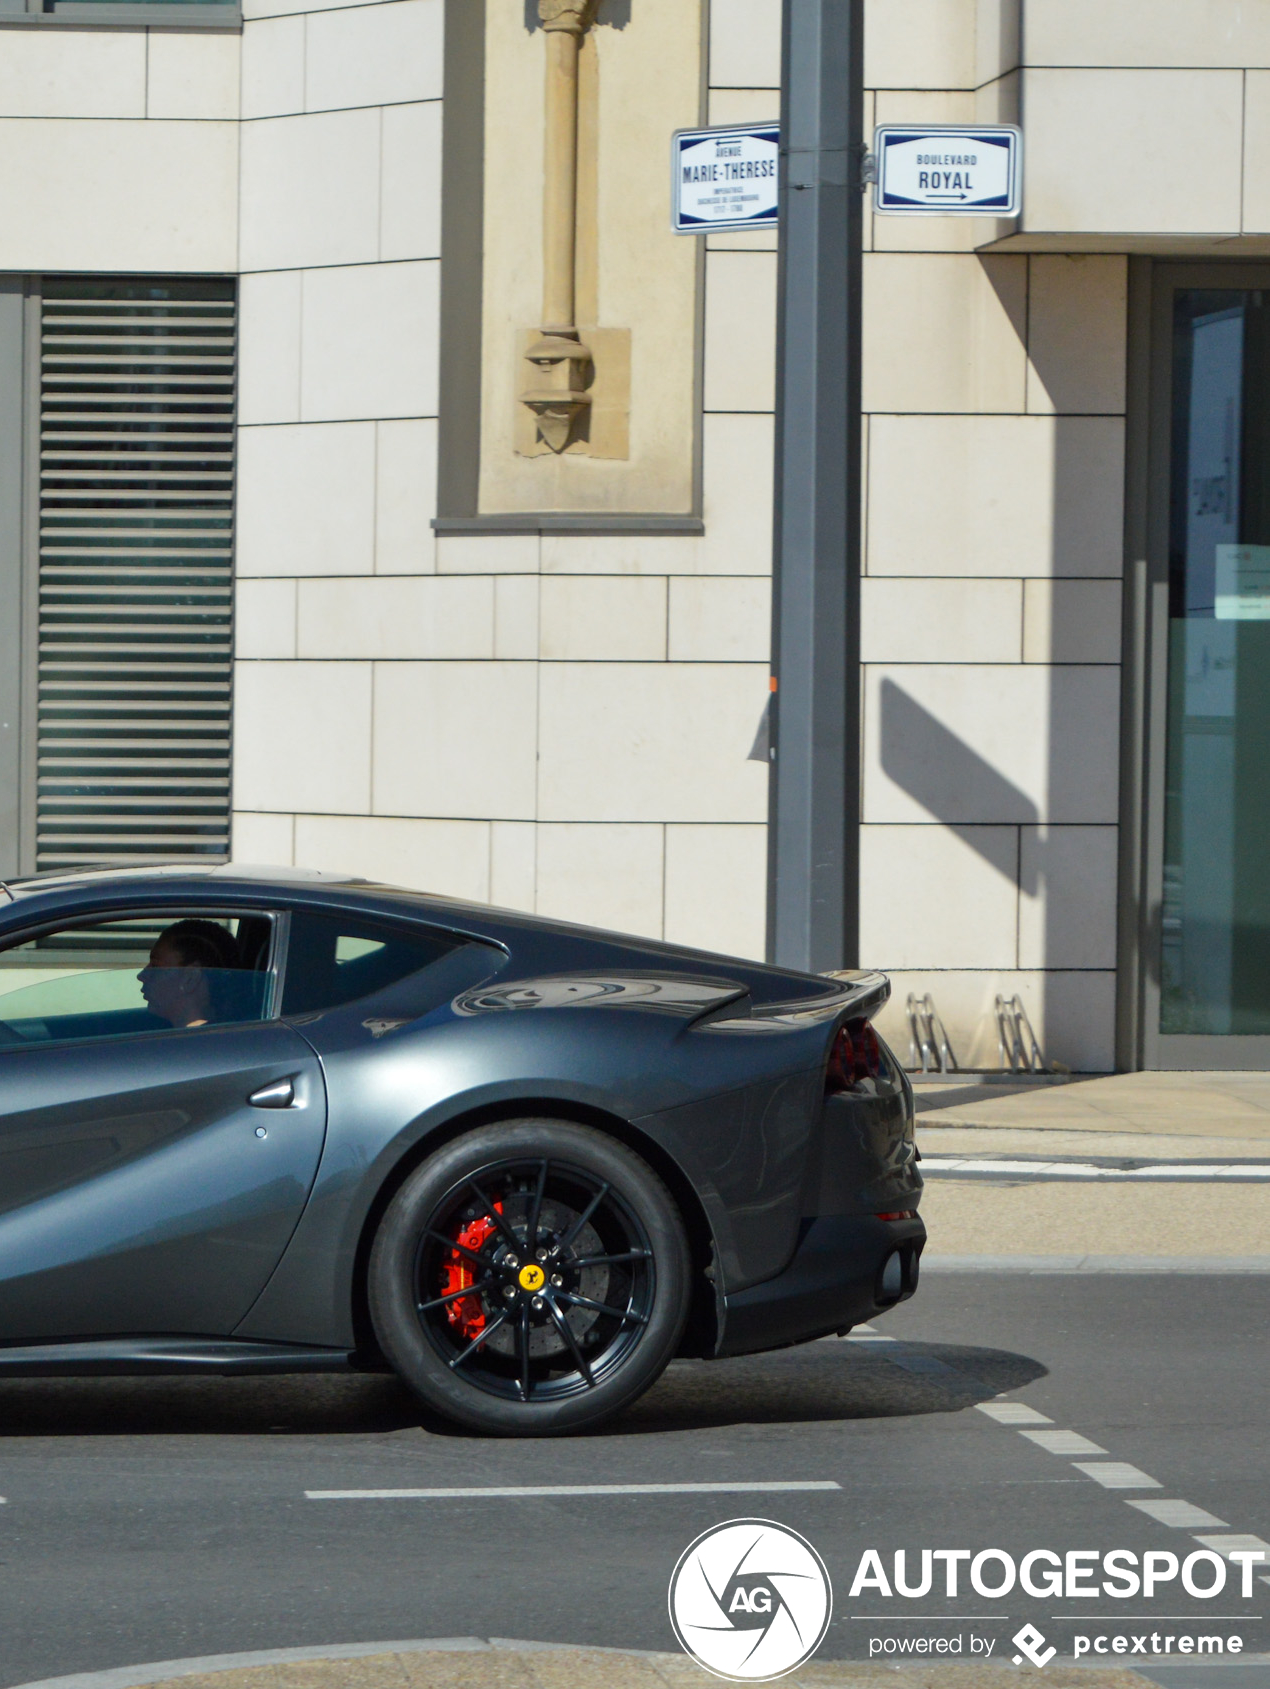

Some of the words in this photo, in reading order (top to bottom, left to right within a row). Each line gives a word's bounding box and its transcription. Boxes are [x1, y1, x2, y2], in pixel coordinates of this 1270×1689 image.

[716, 146, 742, 157] AVENUE
[917, 154, 977, 165] BOULEVARD
[683, 160, 774, 183] MARIE-THERESE
[919, 171, 973, 189] ROYAL
